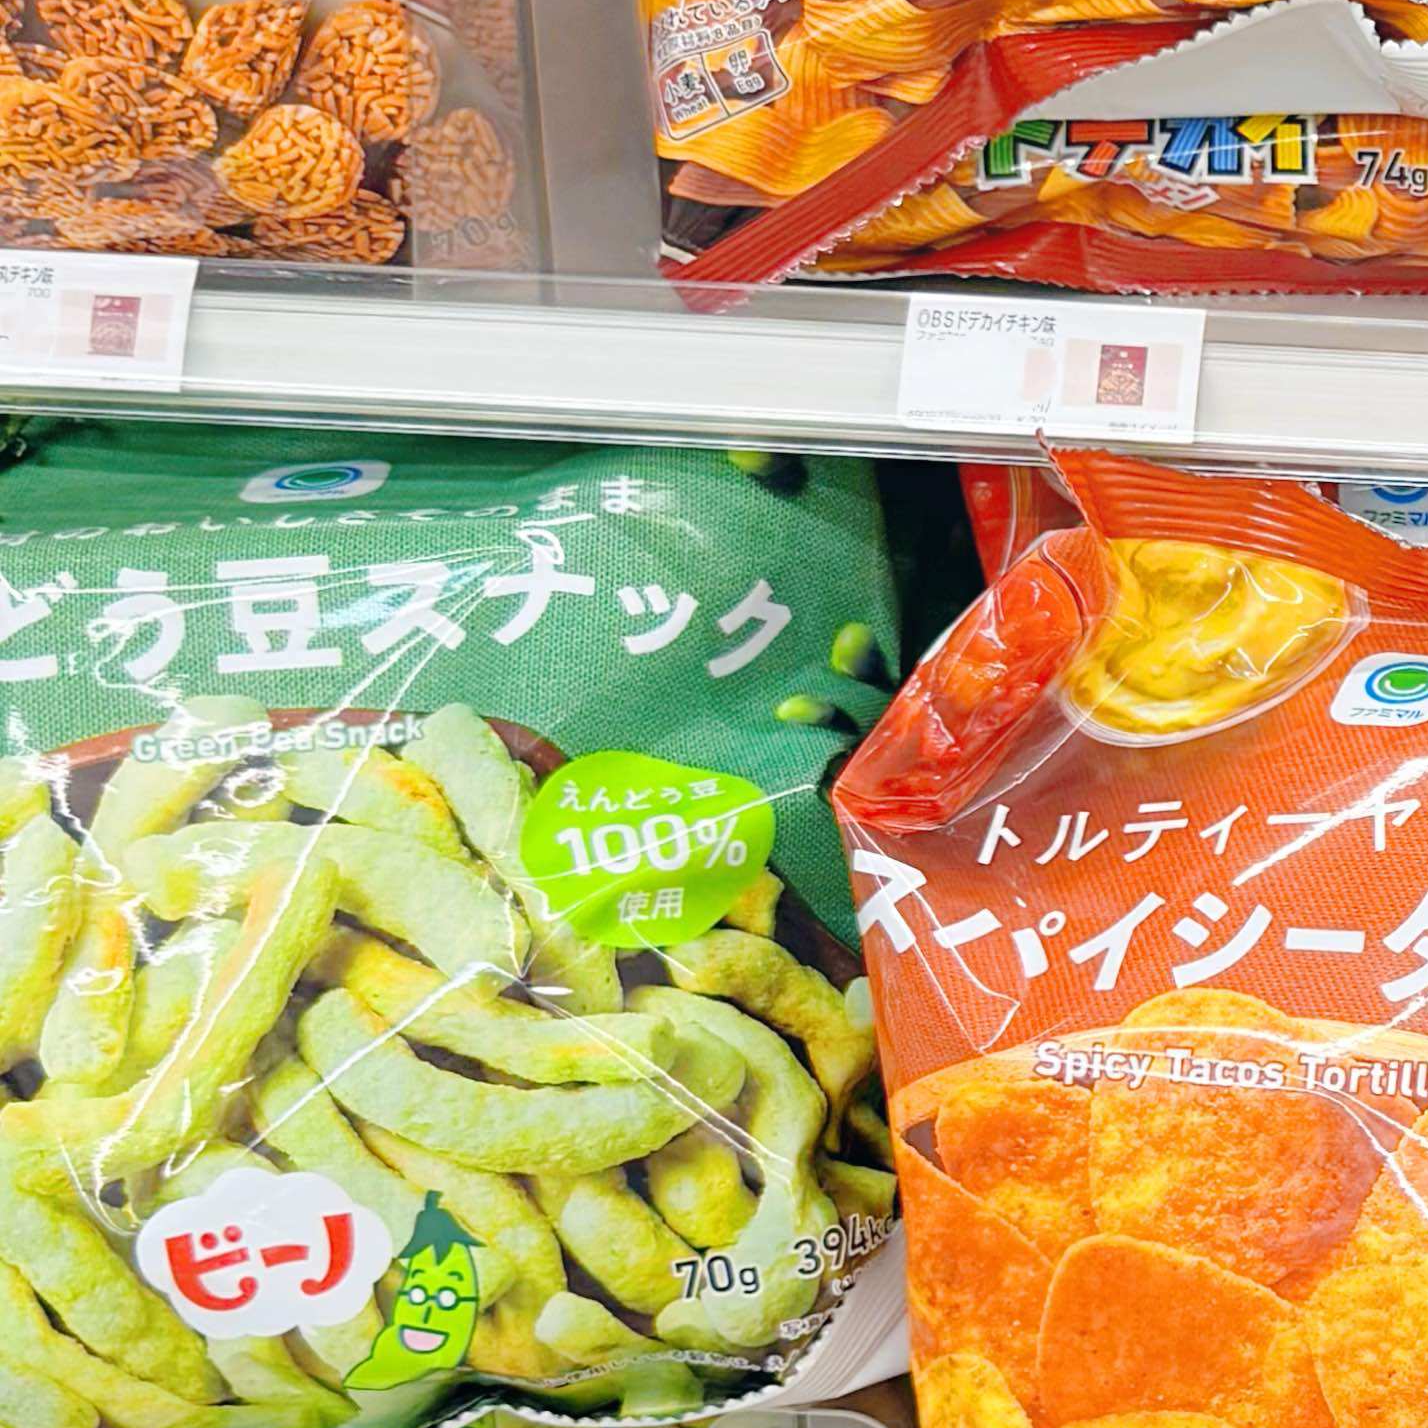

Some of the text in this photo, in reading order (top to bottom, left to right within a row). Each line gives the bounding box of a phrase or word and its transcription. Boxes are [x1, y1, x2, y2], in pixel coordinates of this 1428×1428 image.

[132, 727, 239, 766] Green
[322, 713, 425, 750] Snack
[559, 776, 724, 812] えんどう豆
[555, 811, 748, 878] 100%
[616, 887, 685, 924] 使用
[1036, 1040, 1153, 1086] Spicy
[1167, 1044, 1286, 1090] Tacos
[164, 1212, 357, 1315] ビーノ
[671, 1253, 761, 1301] 70g
